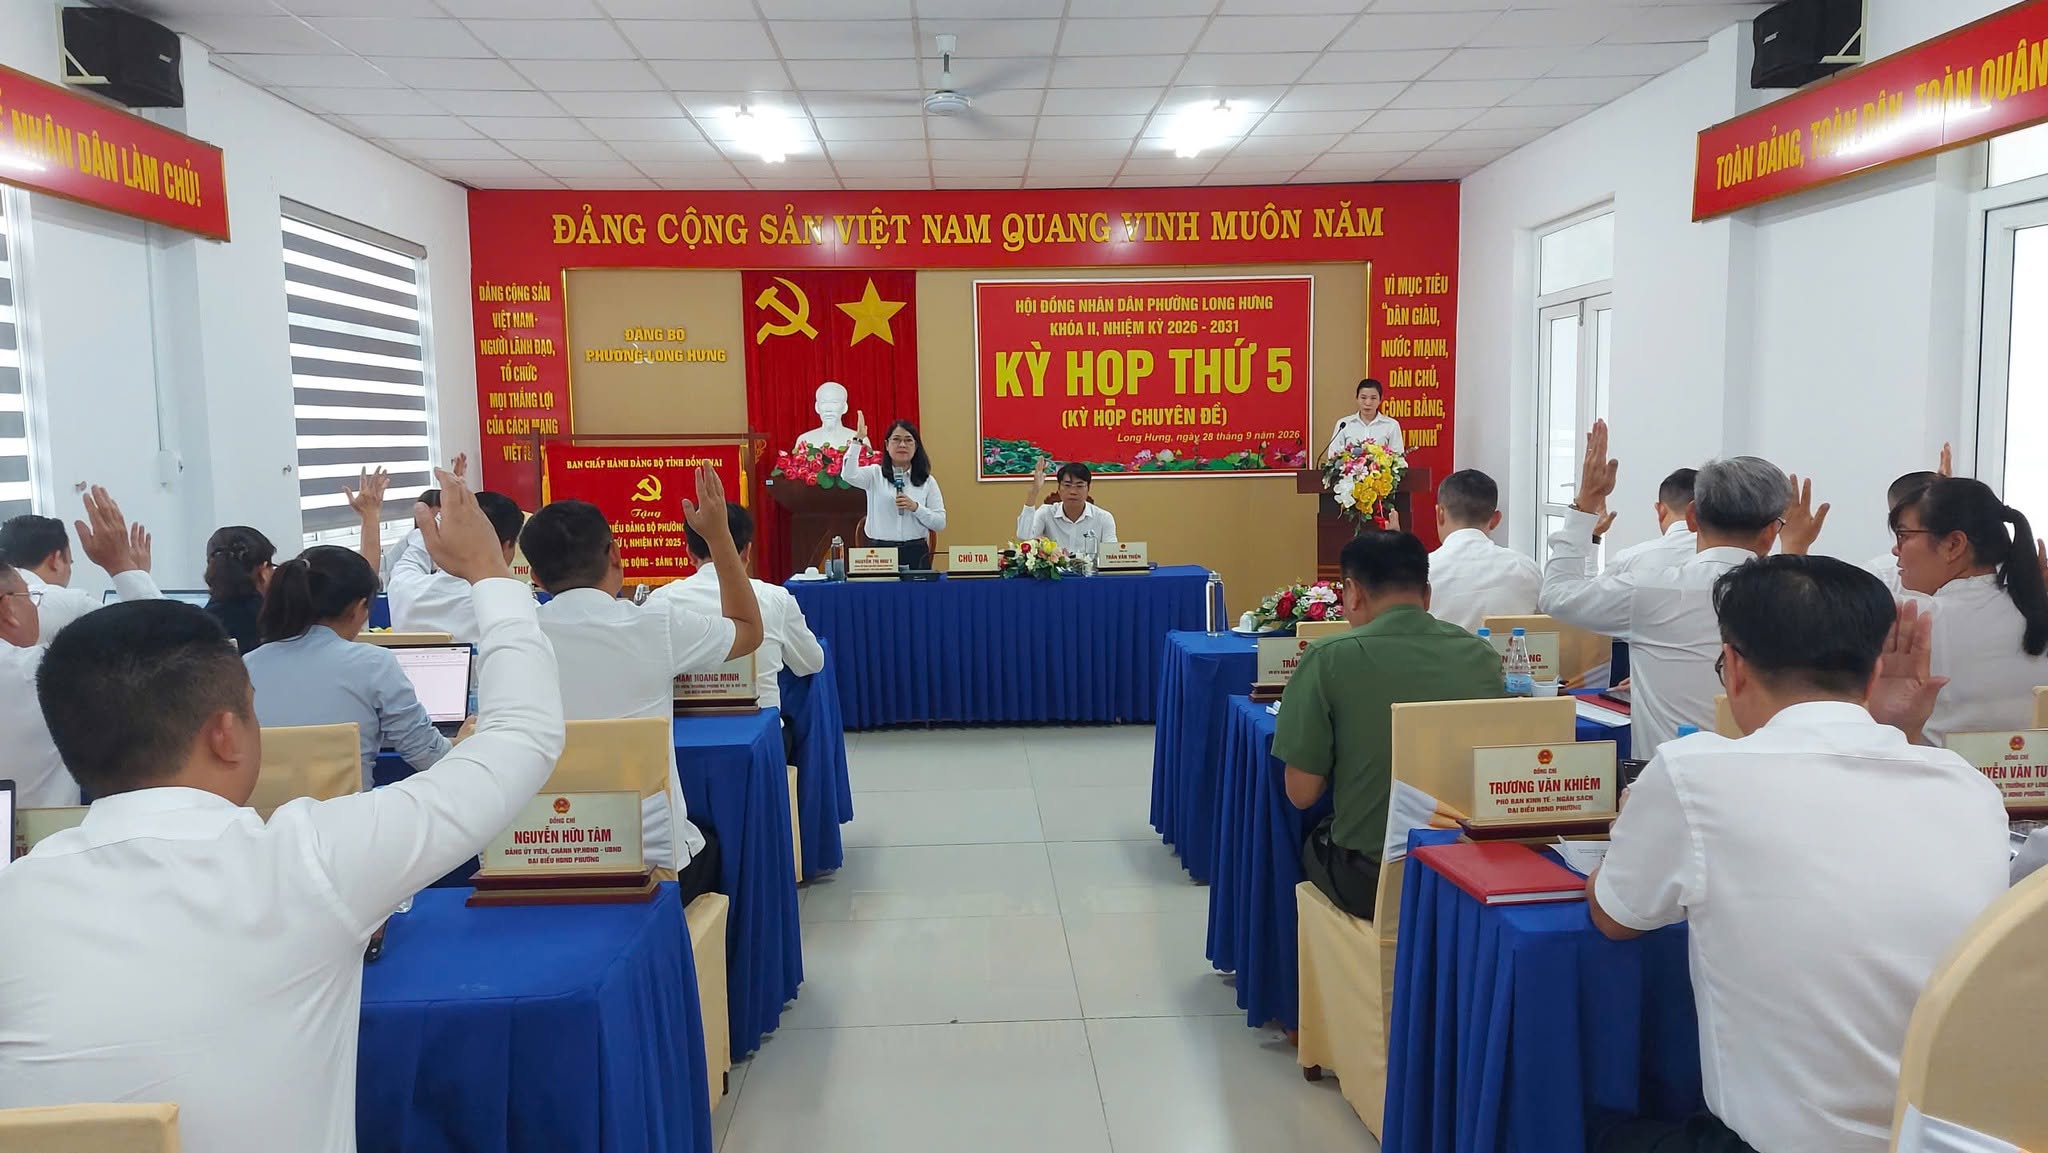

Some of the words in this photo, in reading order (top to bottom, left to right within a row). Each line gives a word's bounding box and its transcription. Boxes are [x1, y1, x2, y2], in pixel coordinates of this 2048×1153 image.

[1716, 139, 1754, 190] TOÀN
[1757, 125, 1804, 178] ĐẢNG,
[1811, 107, 1857, 160] TOÀN
[1915, 66, 1974, 120] TOÀN
[1981, 38, 2048, 108] QUÂN
[12, 109, 74, 169] NHÂN
[78, 130, 118, 182] DÂN
[121, 143, 160, 195] LÀM
[163, 159, 202, 207] CHỦ!
[552, 203, 647, 245] ĐẢNG
[657, 206, 748, 250] CỘNG
[759, 203, 825, 245] SẢN
[833, 207, 911, 250] VIỆT
[922, 214, 991, 244] NAM
[1002, 212, 1112, 252] QUANG
[1120, 211, 1200, 243] VINH
[1210, 202, 1302, 241] MUÔN
[1313, 200, 1384, 238] NĂM
[479, 281, 504, 302] ĐẢNG
[505, 282, 530, 304] CỘNG
[531, 281, 551, 302] SẢN
[1384, 273, 1395, 295] VÌ
[1398, 276, 1422, 297] MỤC
[1425, 272, 1448, 294] TIÊU
[1016, 296, 1037, 316] HỘI
[1078, 295, 1114, 313] NHÂN
[1118, 295, 1144, 312] DÂN
[1147, 294, 1199, 312] PHƯỜNG
[1202, 297, 1235, 311] LONG
[1238, 294, 1274, 310] HƯNG
[1412, 303, 1440, 327] GIÀU,
[492, 309, 512, 331] VIỆT
[1050, 319, 1084, 336] KHÓA
[1087, 321, 1100, 336] II,
[1103, 318, 1144, 338] NHIỆM
[1148, 318, 1164, 335] KỲ
[1167, 320, 1198, 334] 2026
[1210, 319, 1239, 334] 2031
[480, 335, 508, 355] NGƯỜI
[510, 336, 533, 355] LÃNH
[534, 338, 556, 357] ĐẠO,
[646, 348, 684, 362] LONG
[1381, 334, 1411, 358] NƯỚC
[1413, 339, 1448, 360] MẠNH,
[500, 359, 512, 382] TỔ
[513, 362, 538, 382] CHỨC
[995, 341, 1051, 397] KỲ
[1066, 349, 1154, 406] HỌP
[1168, 338, 1257, 394] THỨ
[1266, 347, 1293, 394] 5
[1389, 366, 1412, 388] DÂN
[1414, 364, 1440, 389] CHỦ,
[489, 392, 507, 411] MỌI
[509, 386, 538, 408] THẮNG
[540, 390, 554, 410] LỢI
[1381, 396, 1411, 417] CÔNG
[1413, 393, 1446, 419] BẰNG,
[486, 414, 504, 435] CỦA
[506, 416, 530, 435] CÁCH
[1061, 406, 1089, 429] (KỲ
[1093, 408, 1126, 430] HỌP
[1131, 404, 1196, 426] CHUYÊN
[1200, 401, 1228, 427] ĐỀ)
[1117, 433, 1142, 445] Long
[1144, 432, 1174, 444] Hưng,
[1176, 432, 1200, 444] ngày
[1202, 432, 1214, 441] 28
[1216, 432, 1243, 442] tháng
[1246, 431, 1252, 440] 9
[1278, 430, 1300, 439] 2026
[566, 460, 583, 469] BAN
[584, 456, 606, 469] CHẤP
[630, 536, 652, 550] NHIỆM
[654, 535, 664, 548] KỲ
[665, 537, 682, 547] 2025
[958, 552, 974, 563] CHỦ
[975, 554, 989, 564] TỌA
[2010, 764, 2032, 778] VĂN
[1489, 779, 1534, 794] TRƯƠNG
[1538, 776, 1561, 792] VĂN
[1564, 776, 1600, 792] KHIÊM
[514, 826, 559, 844] NGUYỄN
[562, 827, 584, 843] HỮU
[588, 826, 612, 842] TÂM
